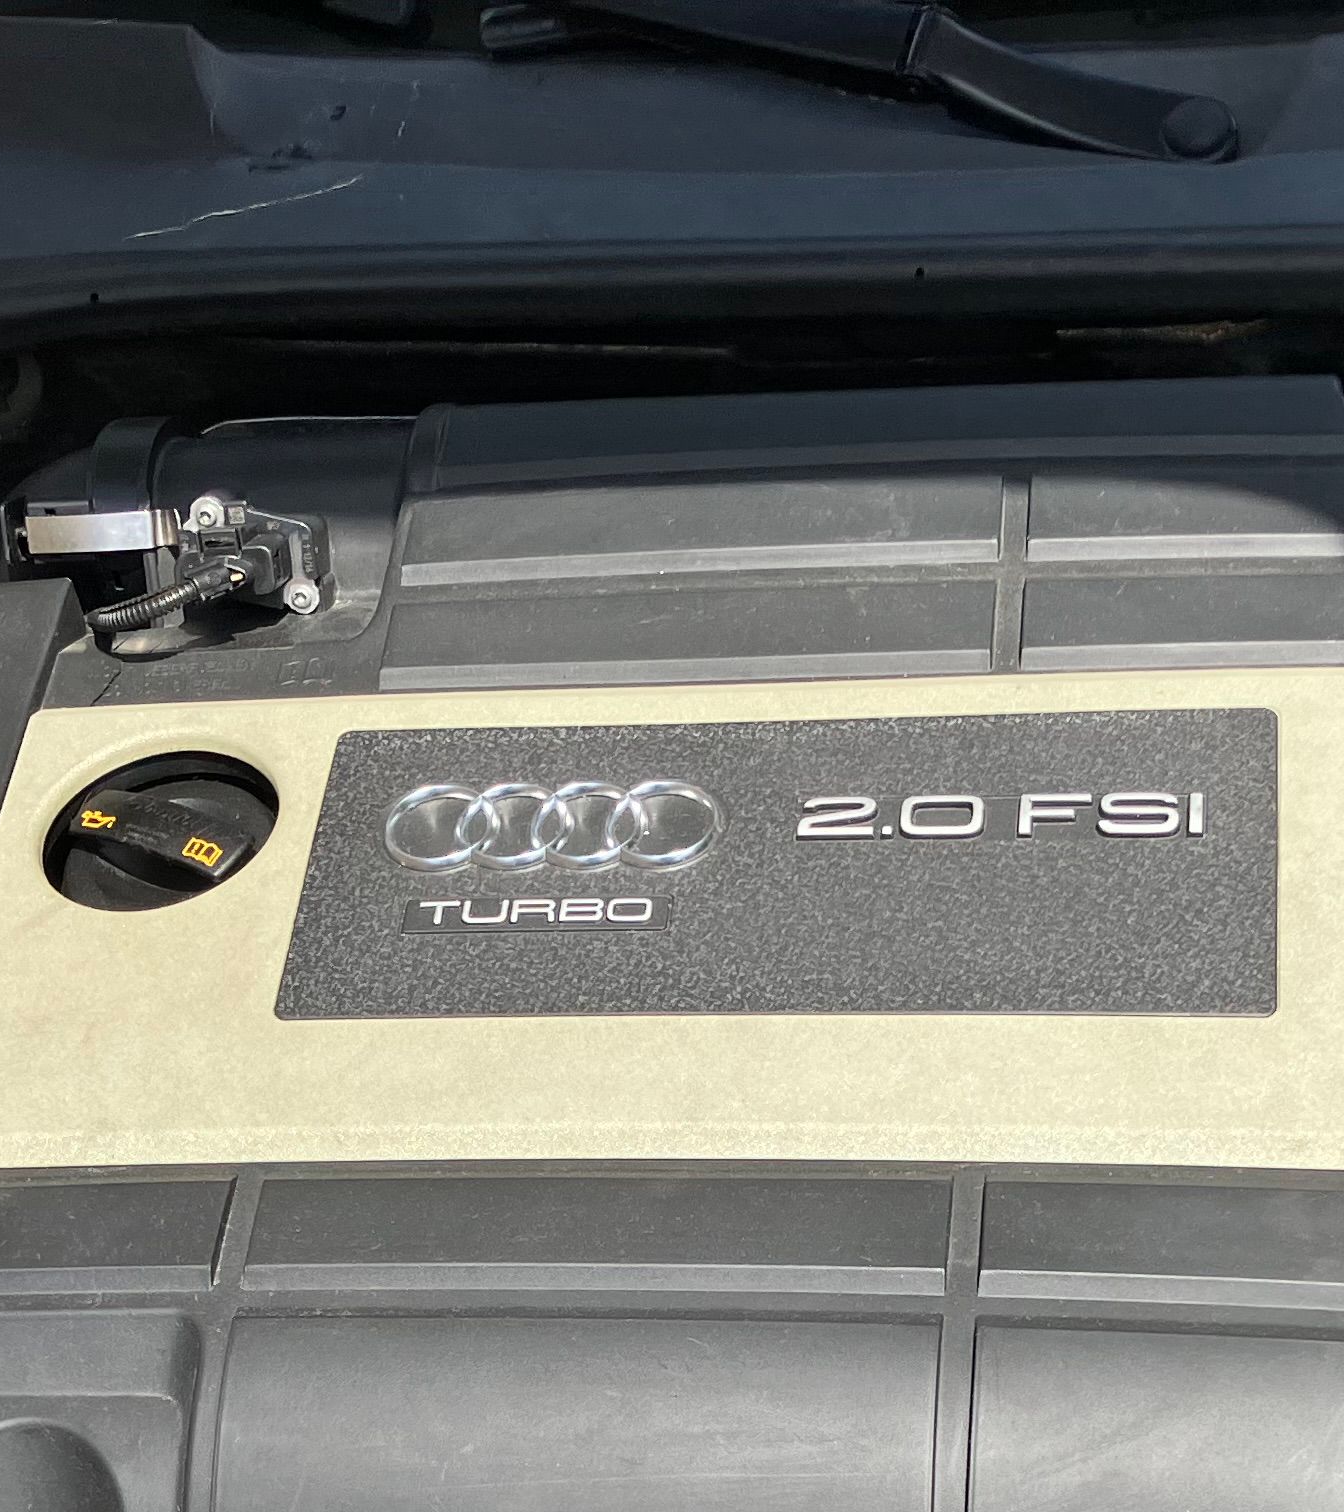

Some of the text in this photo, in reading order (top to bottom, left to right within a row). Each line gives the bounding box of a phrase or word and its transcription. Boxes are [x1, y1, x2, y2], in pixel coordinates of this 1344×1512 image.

[795, 791, 1205, 841] 2.0 FSI
[419, 896, 654, 925] TURBO
